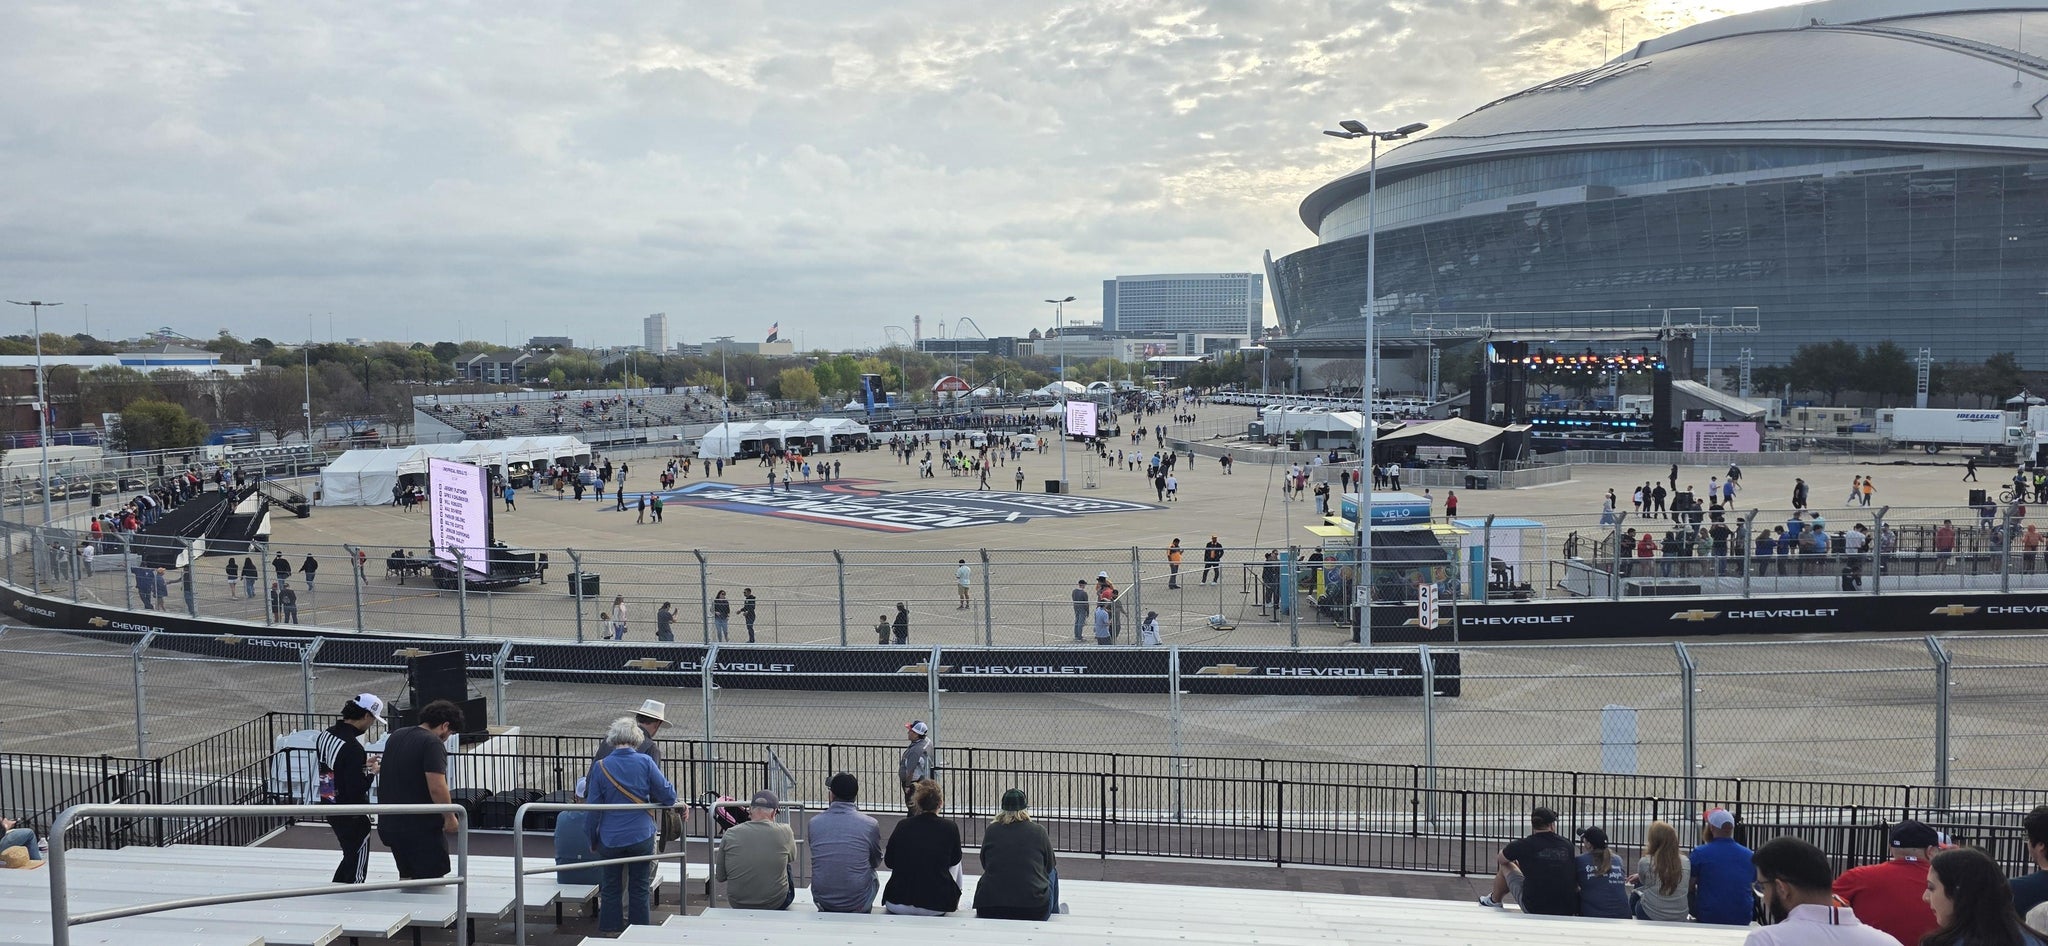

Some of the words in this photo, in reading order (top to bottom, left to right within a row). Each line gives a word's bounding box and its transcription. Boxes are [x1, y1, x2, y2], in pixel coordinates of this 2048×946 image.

[686, 492, 1000, 527] ARLINGTON
[1381, 508, 1410, 518] VELO
[24, 604, 56, 617] CHEVROLET
[1727, 608, 1839, 618] CHEVROLET
[1462, 615, 1574, 625] CHEVROLET
[112, 621, 164, 633] CHEVROLET
[248, 638, 312, 650] CHEVROLE
[680, 661, 795, 671] CHEVROLET
[961, 665, 1087, 675] CHEVROLET
[1266, 667, 1403, 676] CHEVROLET
